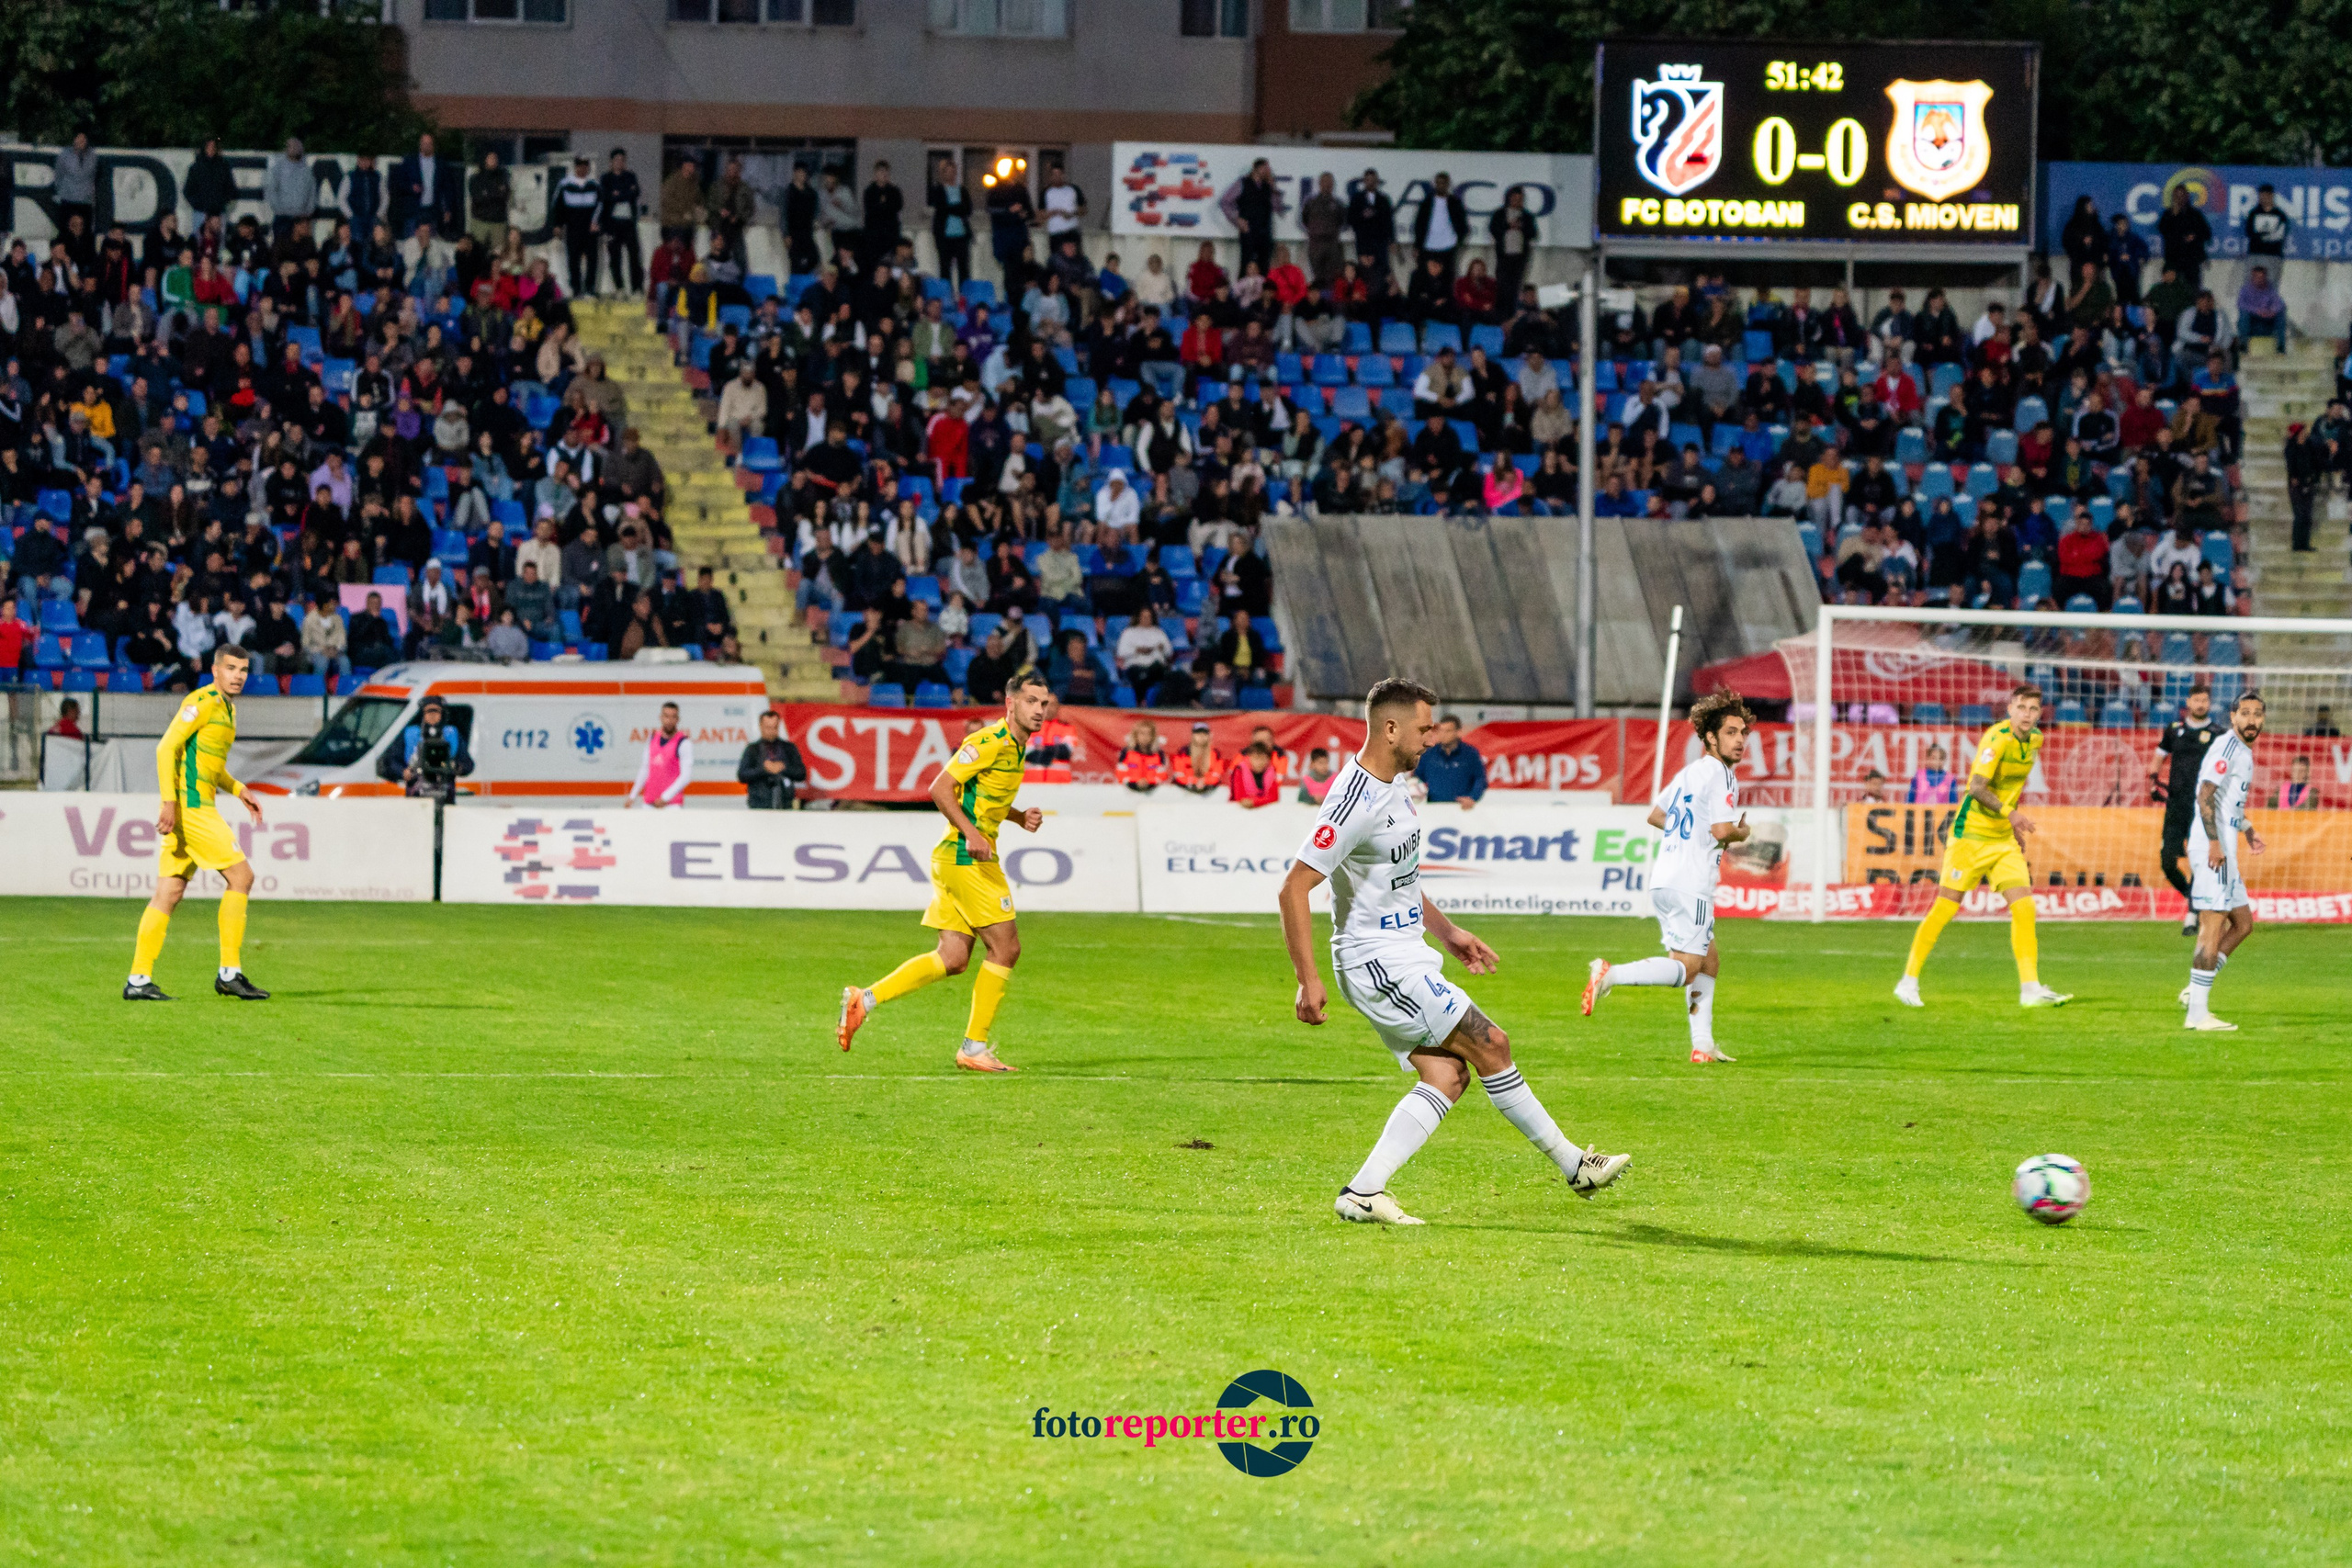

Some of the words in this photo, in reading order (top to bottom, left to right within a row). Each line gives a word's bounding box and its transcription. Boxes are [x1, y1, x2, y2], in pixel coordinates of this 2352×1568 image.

[1765, 61, 1844, 90] 51:42
[1752, 116, 1869, 186] 0-0
[1621, 197, 1661, 226] FC
[1663, 198, 1805, 228] BOTOSANI
[1847, 202, 1902, 230] C.S.
[1905, 203, 2018, 231] MIOVENI
[64, 806, 311, 862] Vera
[1425, 827, 1580, 863] Smart
[670, 840, 1073, 886] ELSAO
[1713, 885, 1874, 912] SUPERBET
[1424, 975, 1451, 998] 4
